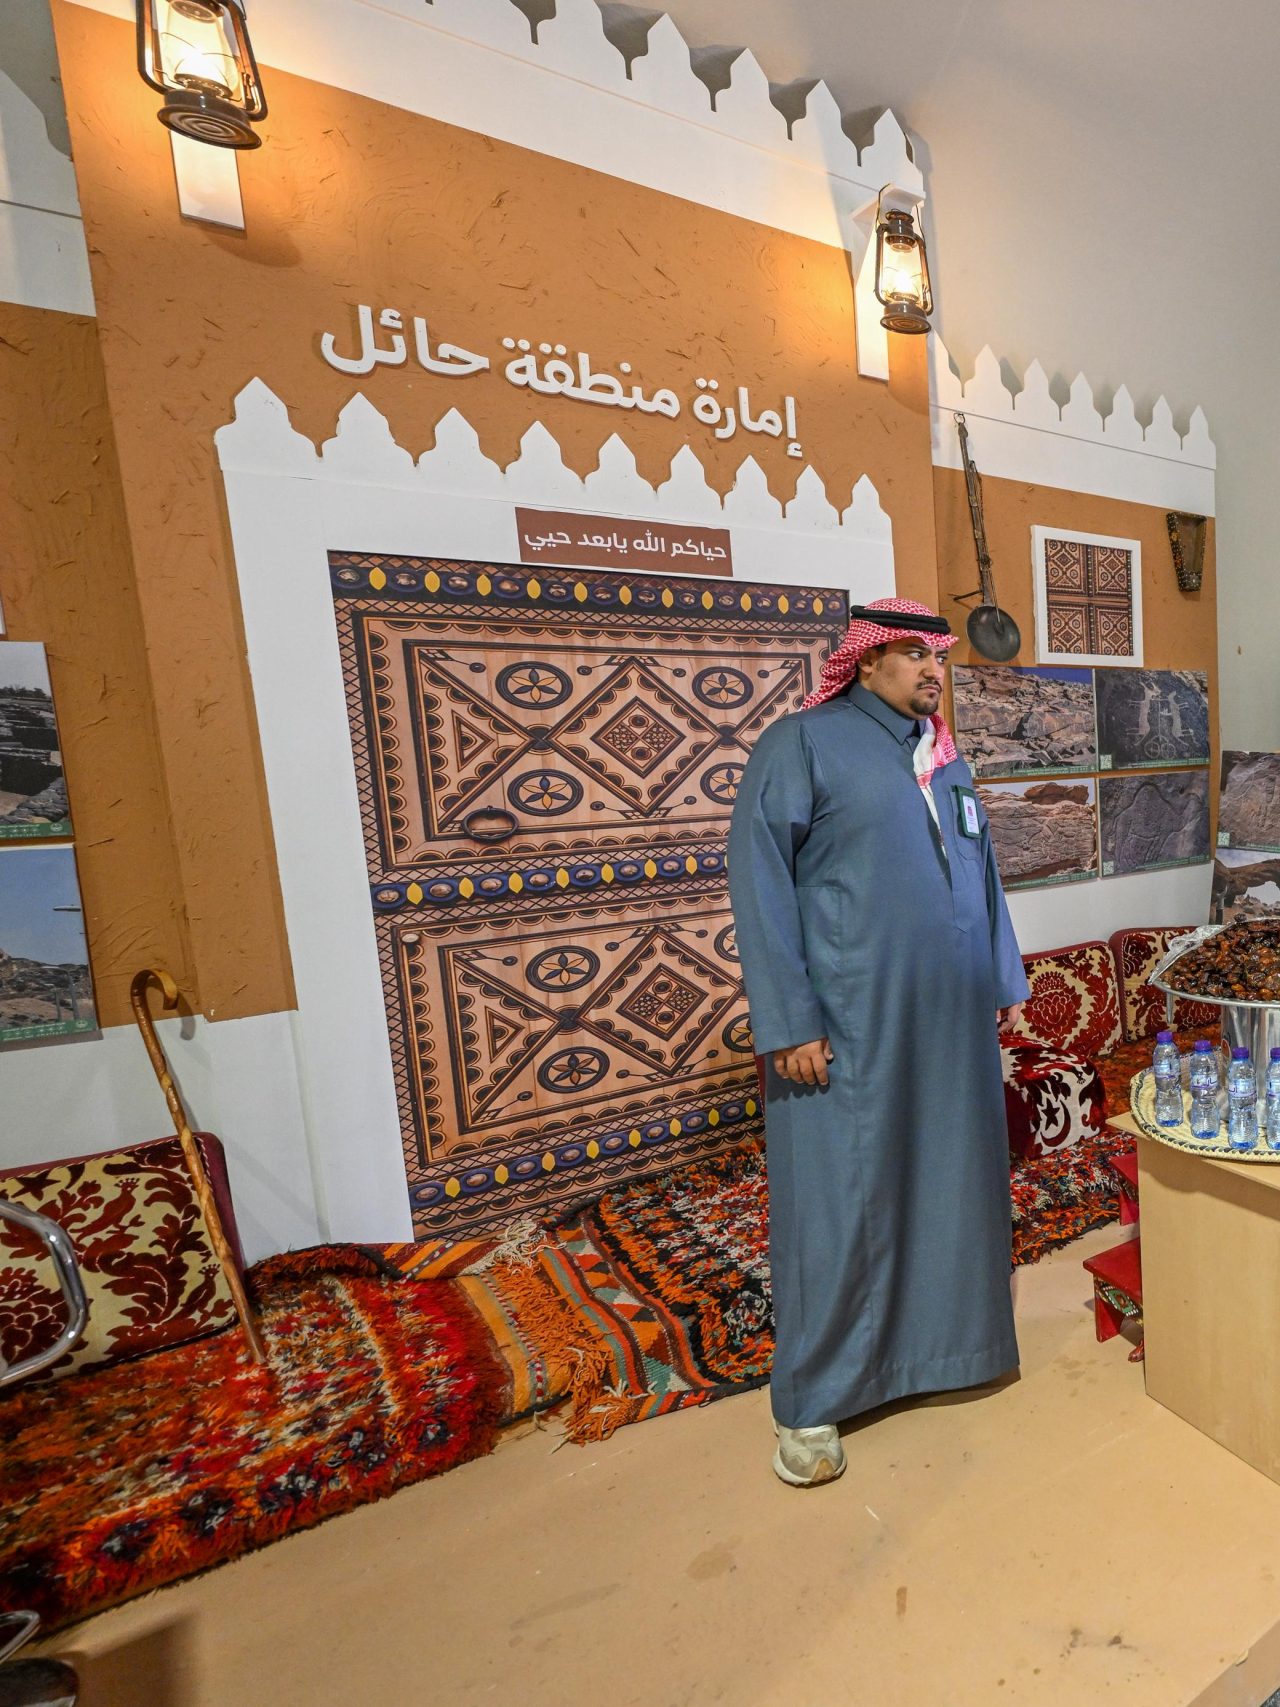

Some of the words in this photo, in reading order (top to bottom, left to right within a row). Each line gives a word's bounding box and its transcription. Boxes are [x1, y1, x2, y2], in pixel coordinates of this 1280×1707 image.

[320, 304, 490, 376] حائل
[502, 337, 681, 418] منطقة
[692, 377, 803, 458] إمارة
[523, 530, 573, 552] حيي
[632, 528, 666, 553] الله
[669, 538, 728, 561] حياكم
